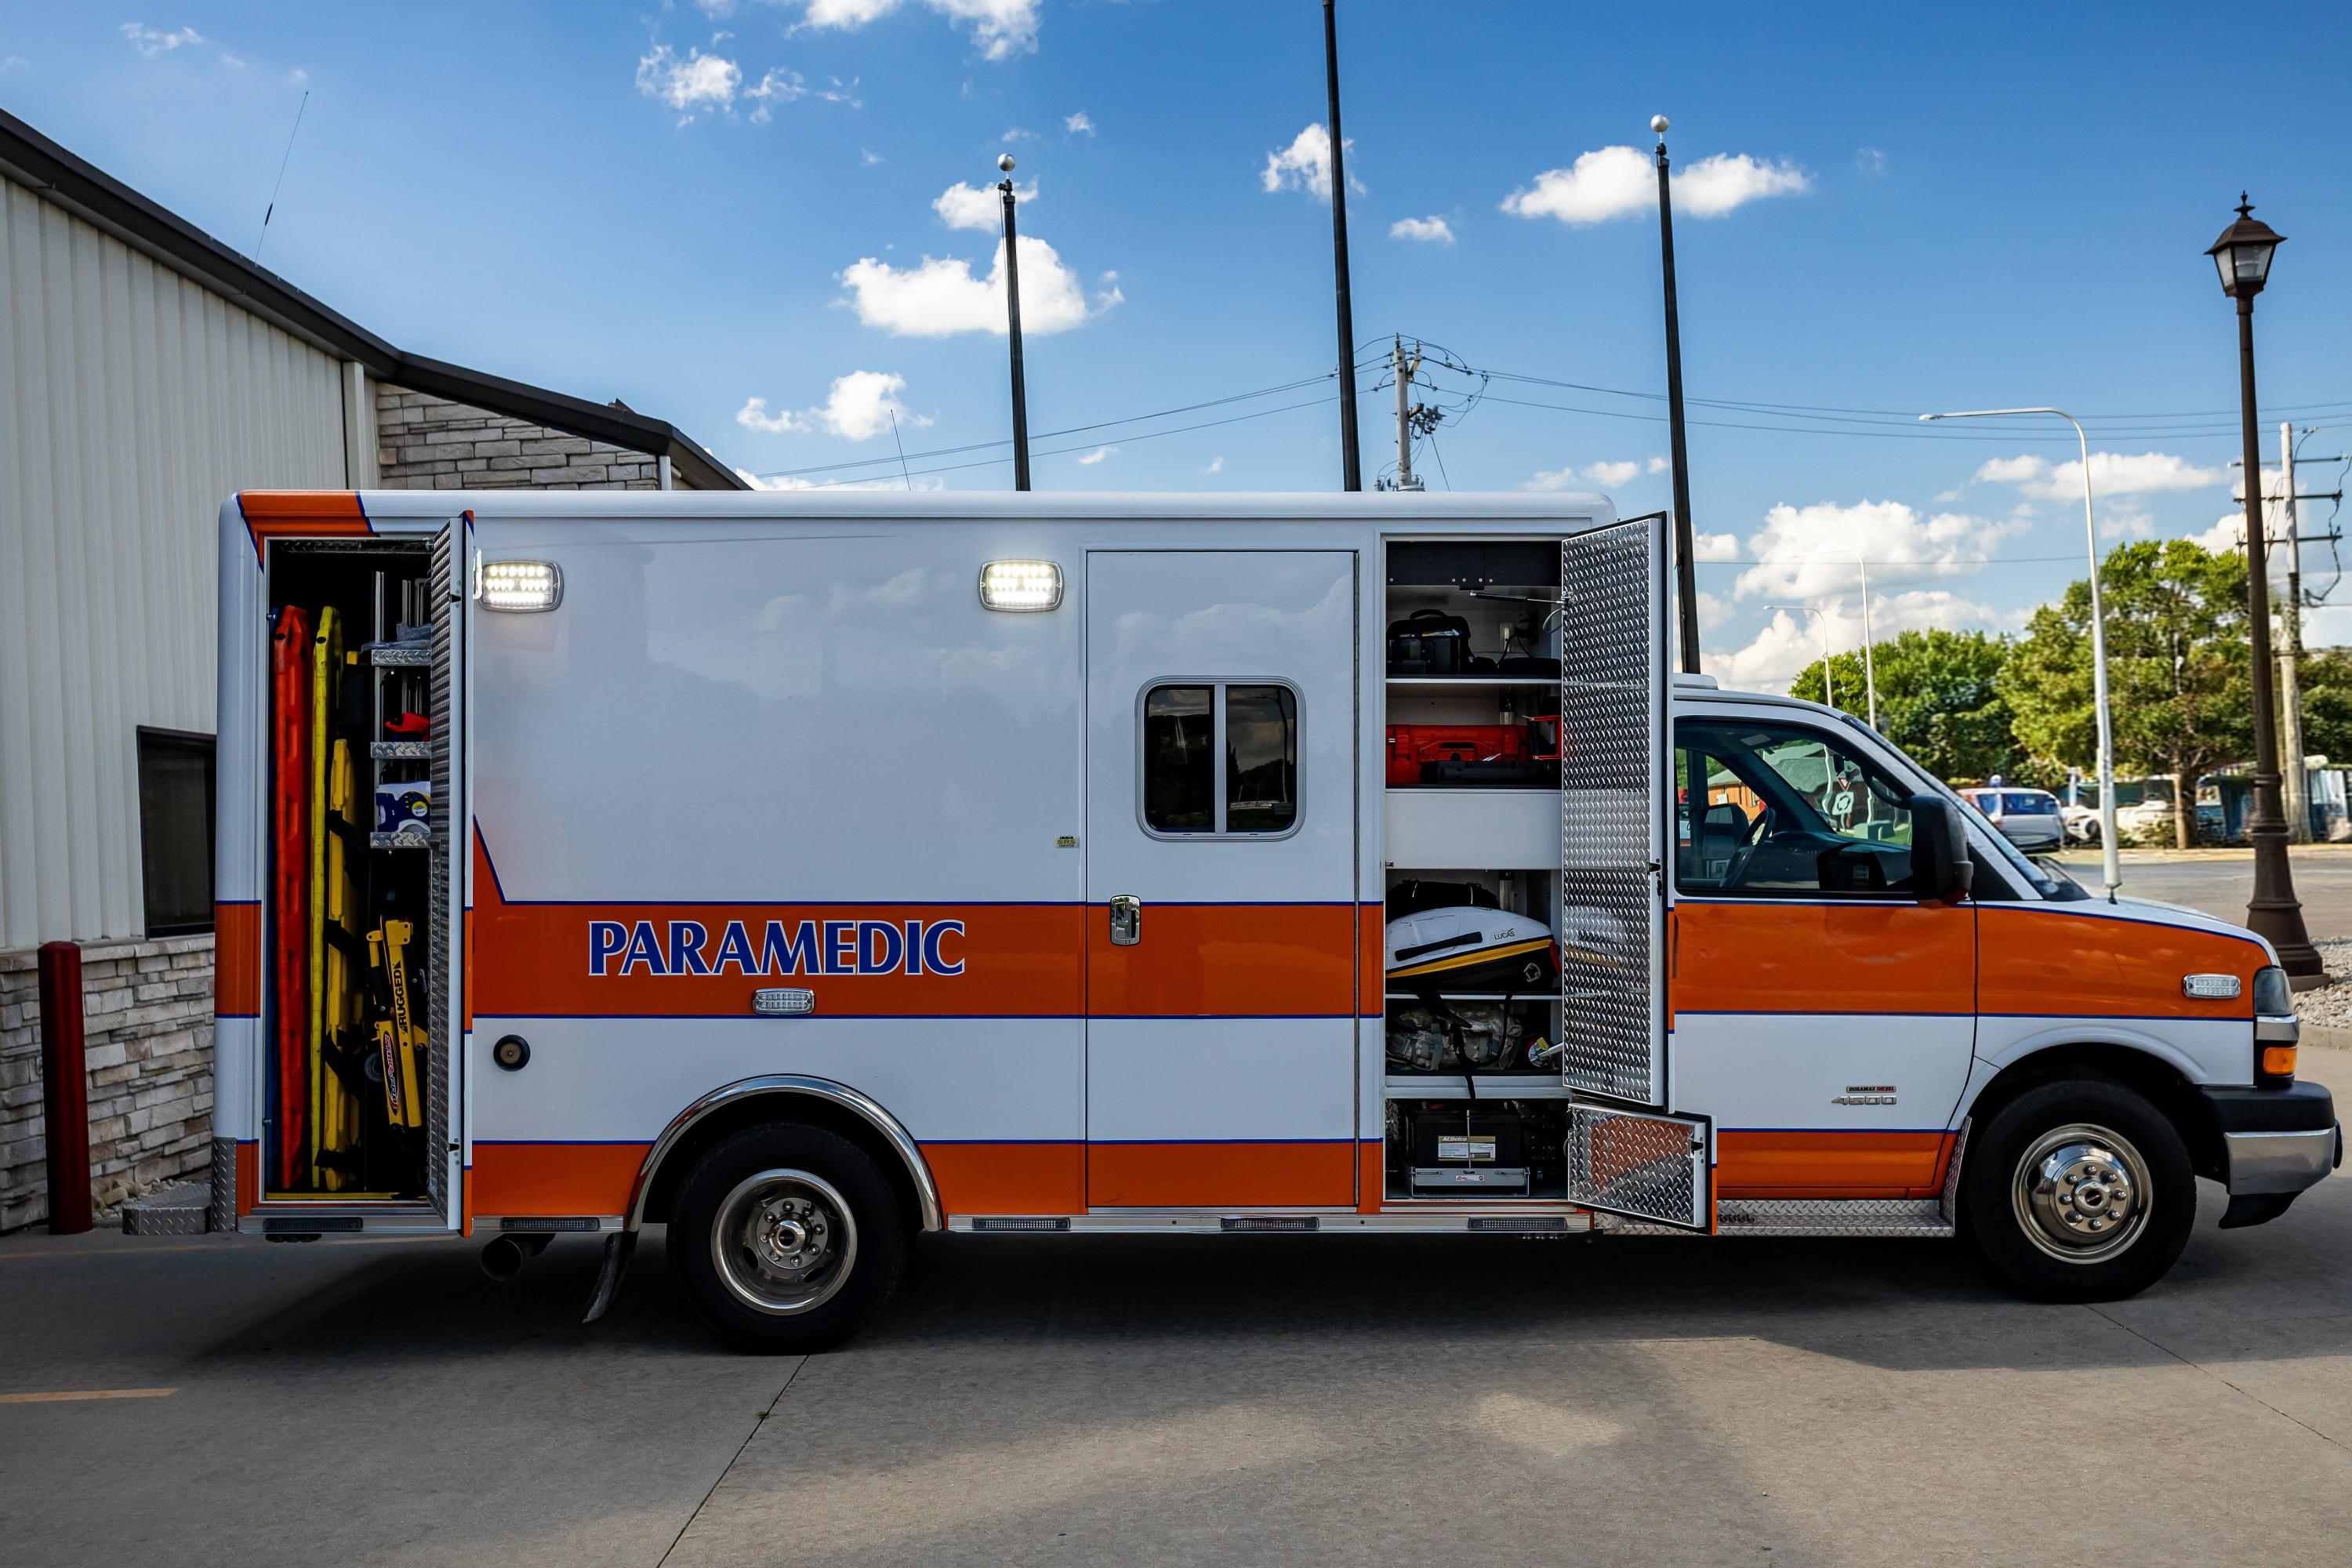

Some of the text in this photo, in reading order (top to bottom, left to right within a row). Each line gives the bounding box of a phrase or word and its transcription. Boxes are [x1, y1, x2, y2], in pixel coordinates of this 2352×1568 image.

[588, 919, 965, 976] PARAMEDIC
[1494, 927, 1515, 940] LUCAS
[393, 969, 408, 1026] RUGGED
[1831, 1095, 1897, 1105] 4500
